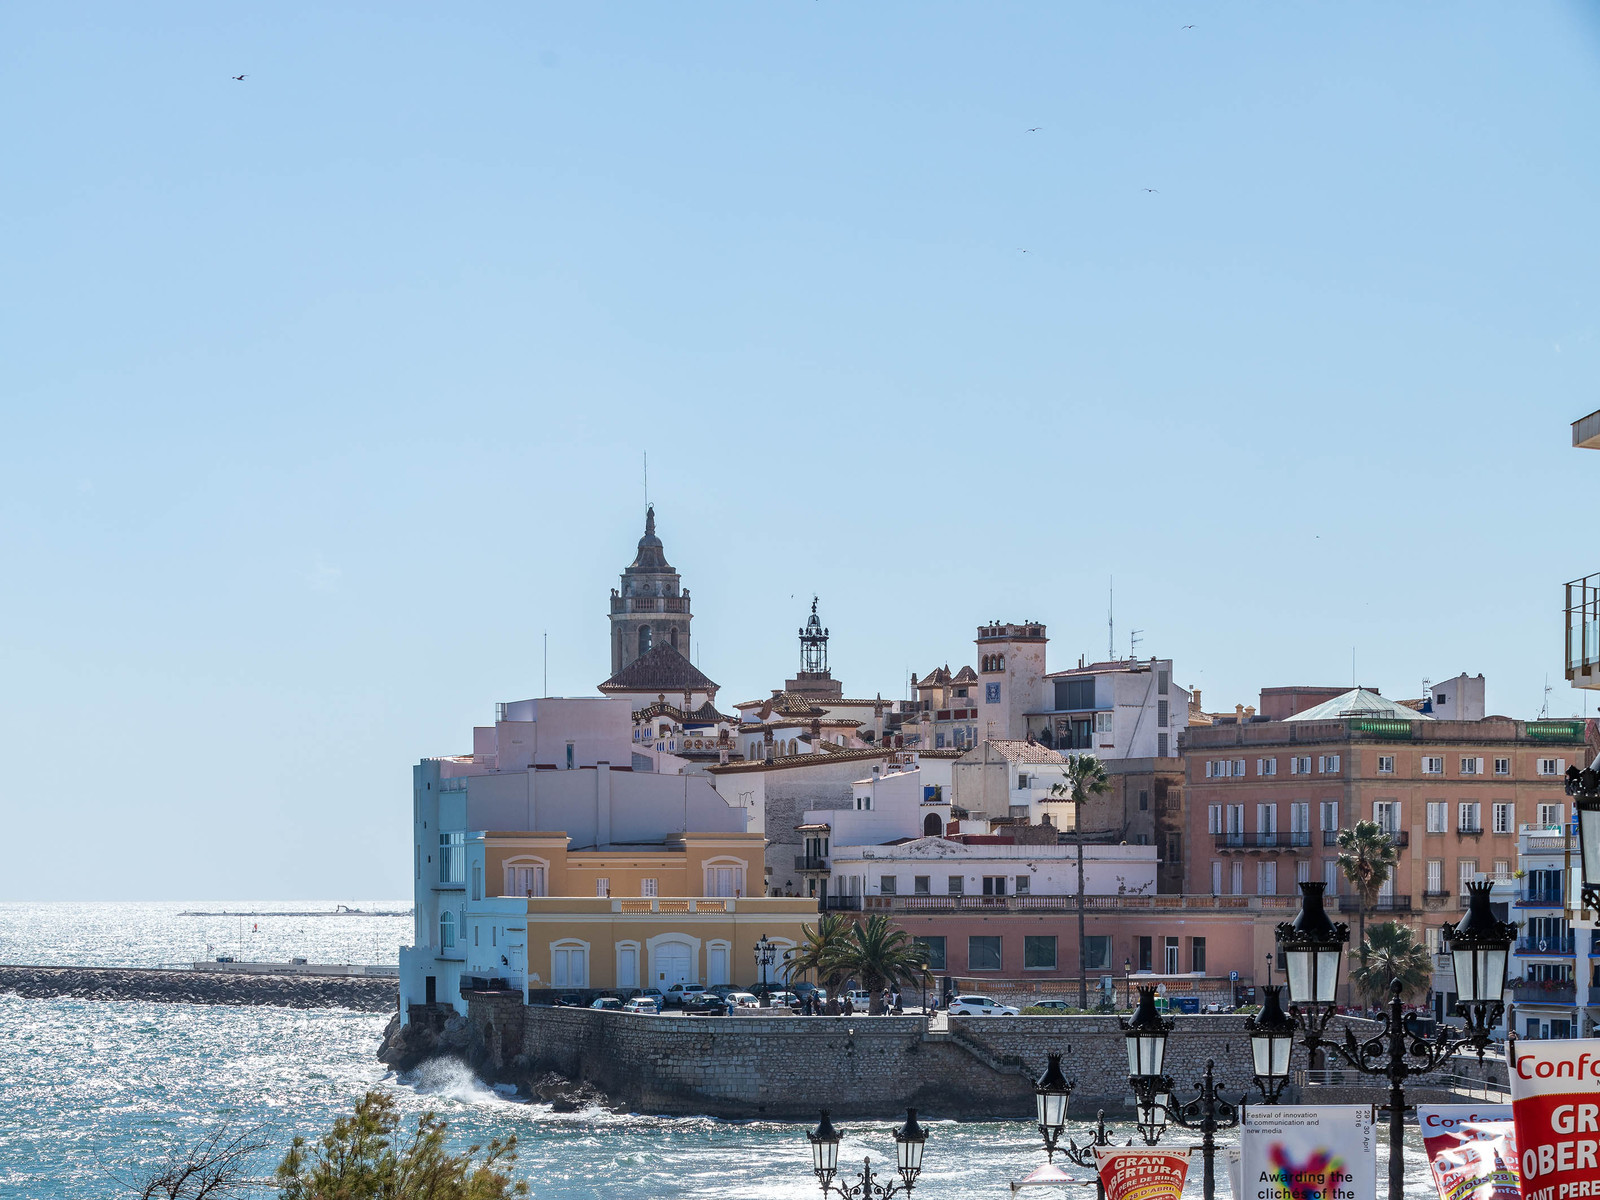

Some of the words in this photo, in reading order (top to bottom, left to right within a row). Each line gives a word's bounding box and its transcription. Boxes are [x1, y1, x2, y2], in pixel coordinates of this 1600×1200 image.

[1551, 1103, 1600, 1135] GR
[1363, 1125, 1370, 1135] 30
[1362, 1137, 1370, 1153] April
[1114, 1157, 1165, 1170] GRAN
[1522, 1139, 1600, 1180] OBER
[1108, 1165, 1183, 1200] OBERTURA
[1259, 1171, 1325, 1185] Awarding
[1330, 1171, 1353, 1183] the
[1492, 1173, 1509, 1181] 28
[1257, 1188, 1308, 1200] clichés
[1313, 1187, 1327, 1200] of
[1332, 1188, 1355, 1200] the
[1559, 1180, 1600, 1200] PERE
